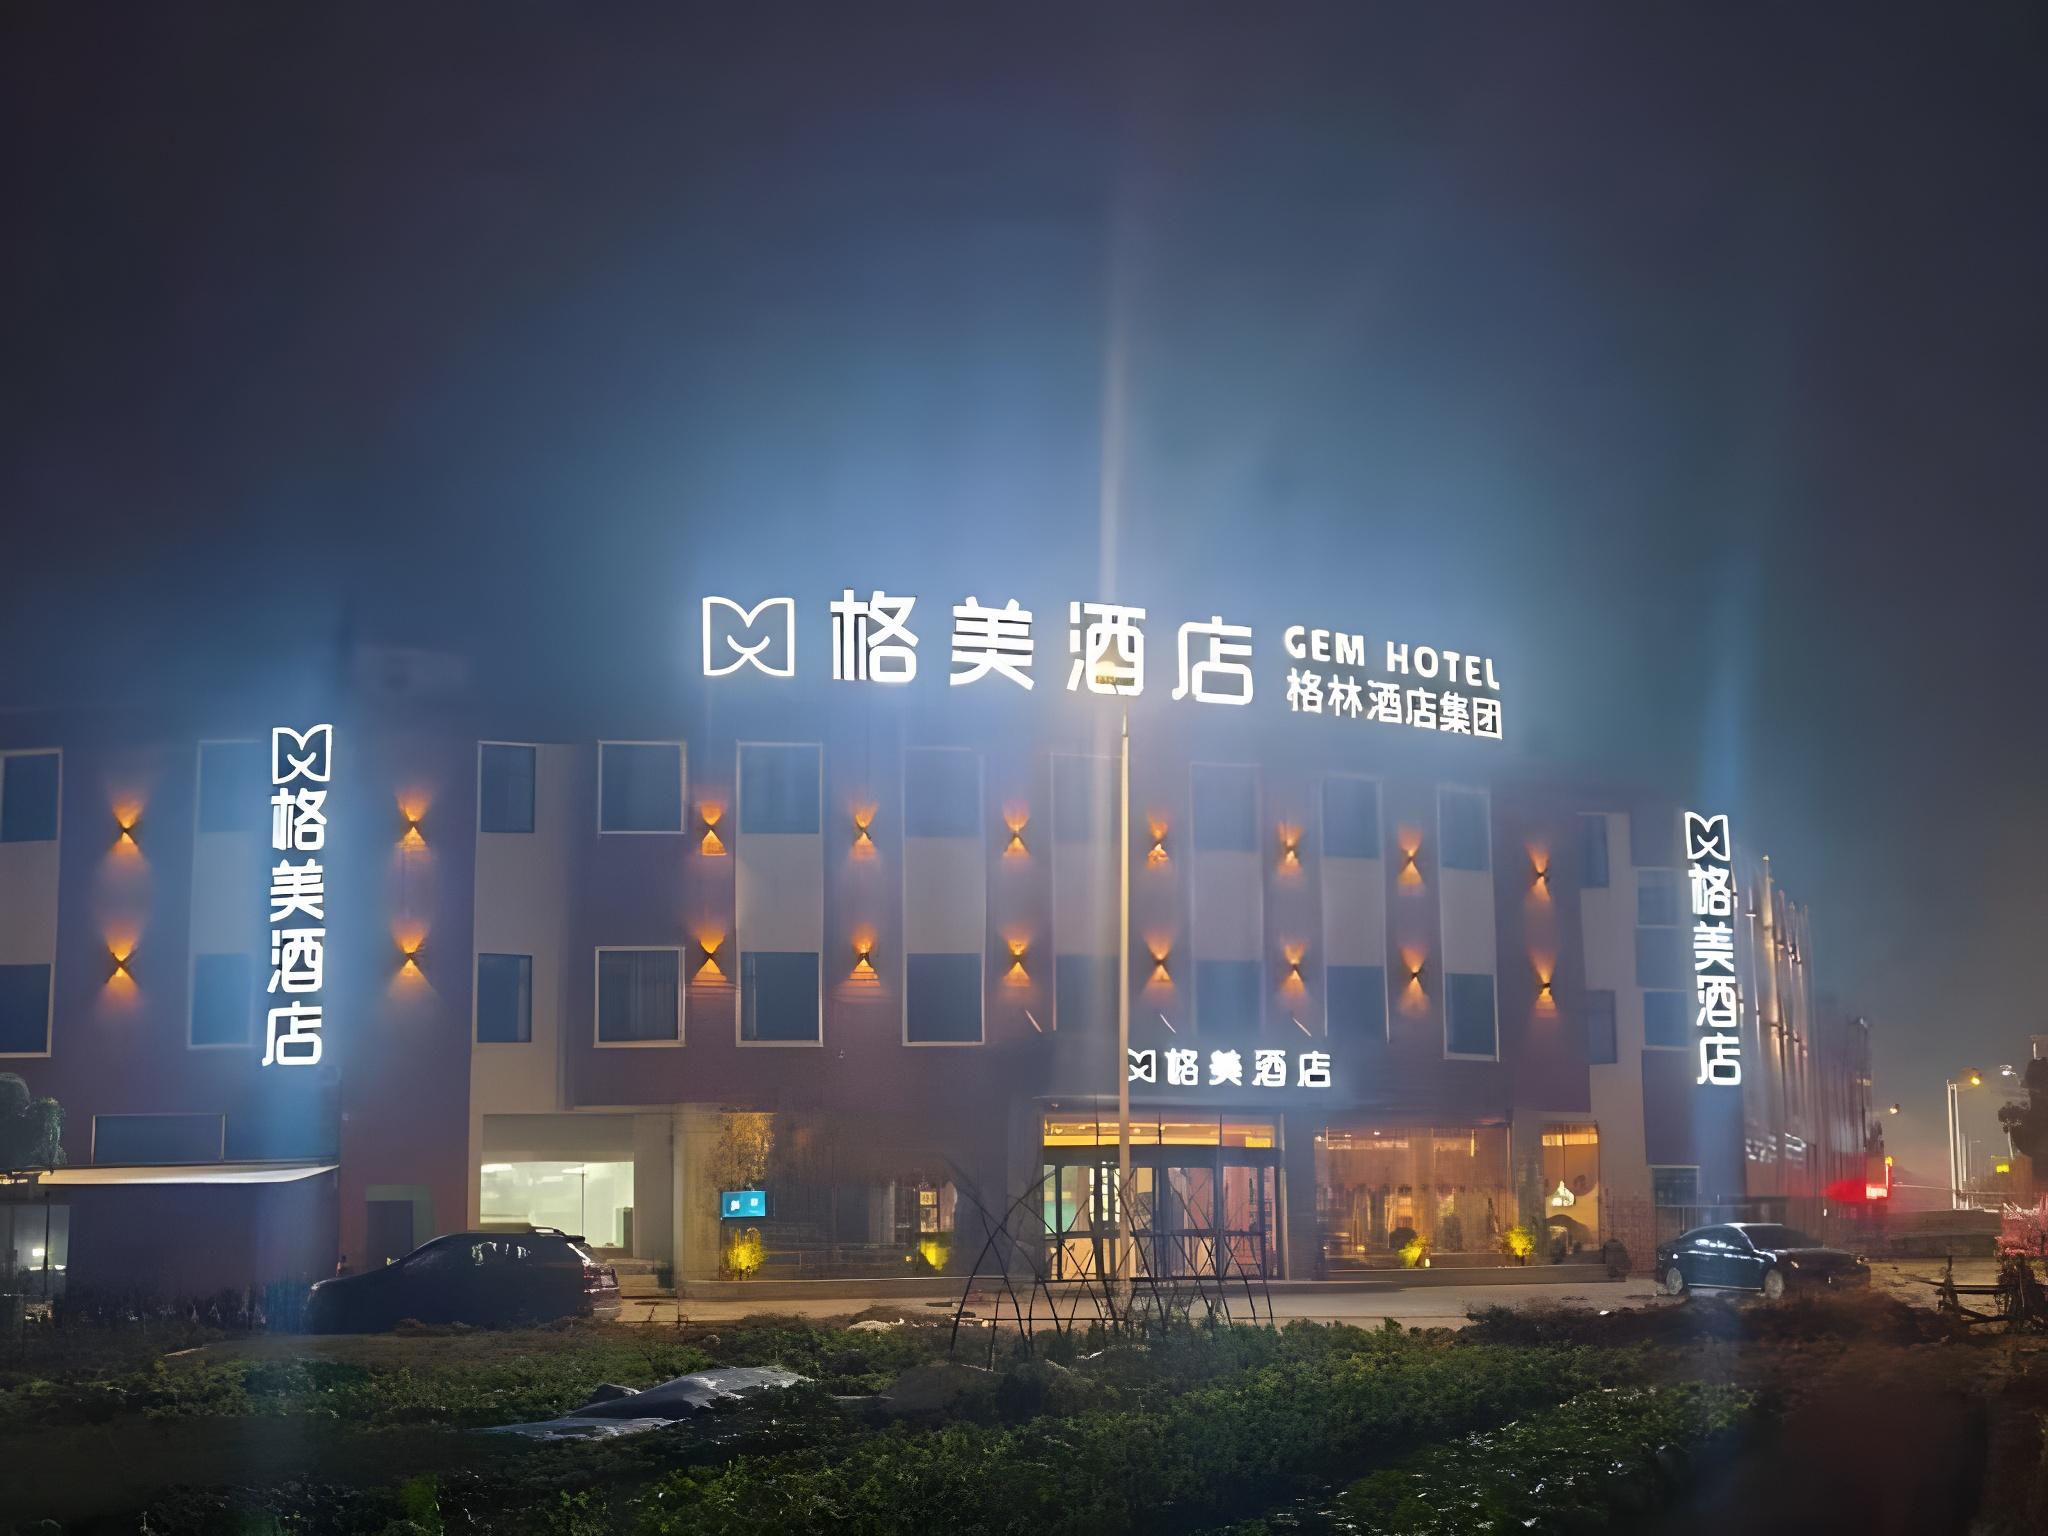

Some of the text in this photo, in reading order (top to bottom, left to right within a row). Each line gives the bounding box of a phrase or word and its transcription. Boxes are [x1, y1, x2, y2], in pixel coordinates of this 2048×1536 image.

[830, 588, 1253, 705] 格美酒店
[1284, 625, 1500, 690] GEM HOTEL
[1286, 667, 1503, 740] 格林酒店集团
[262, 787, 328, 1066] 格美酒店
[1687, 862, 1741, 1085] 格美酒店
[1164, 1048, 1331, 1087] 格美酒店
